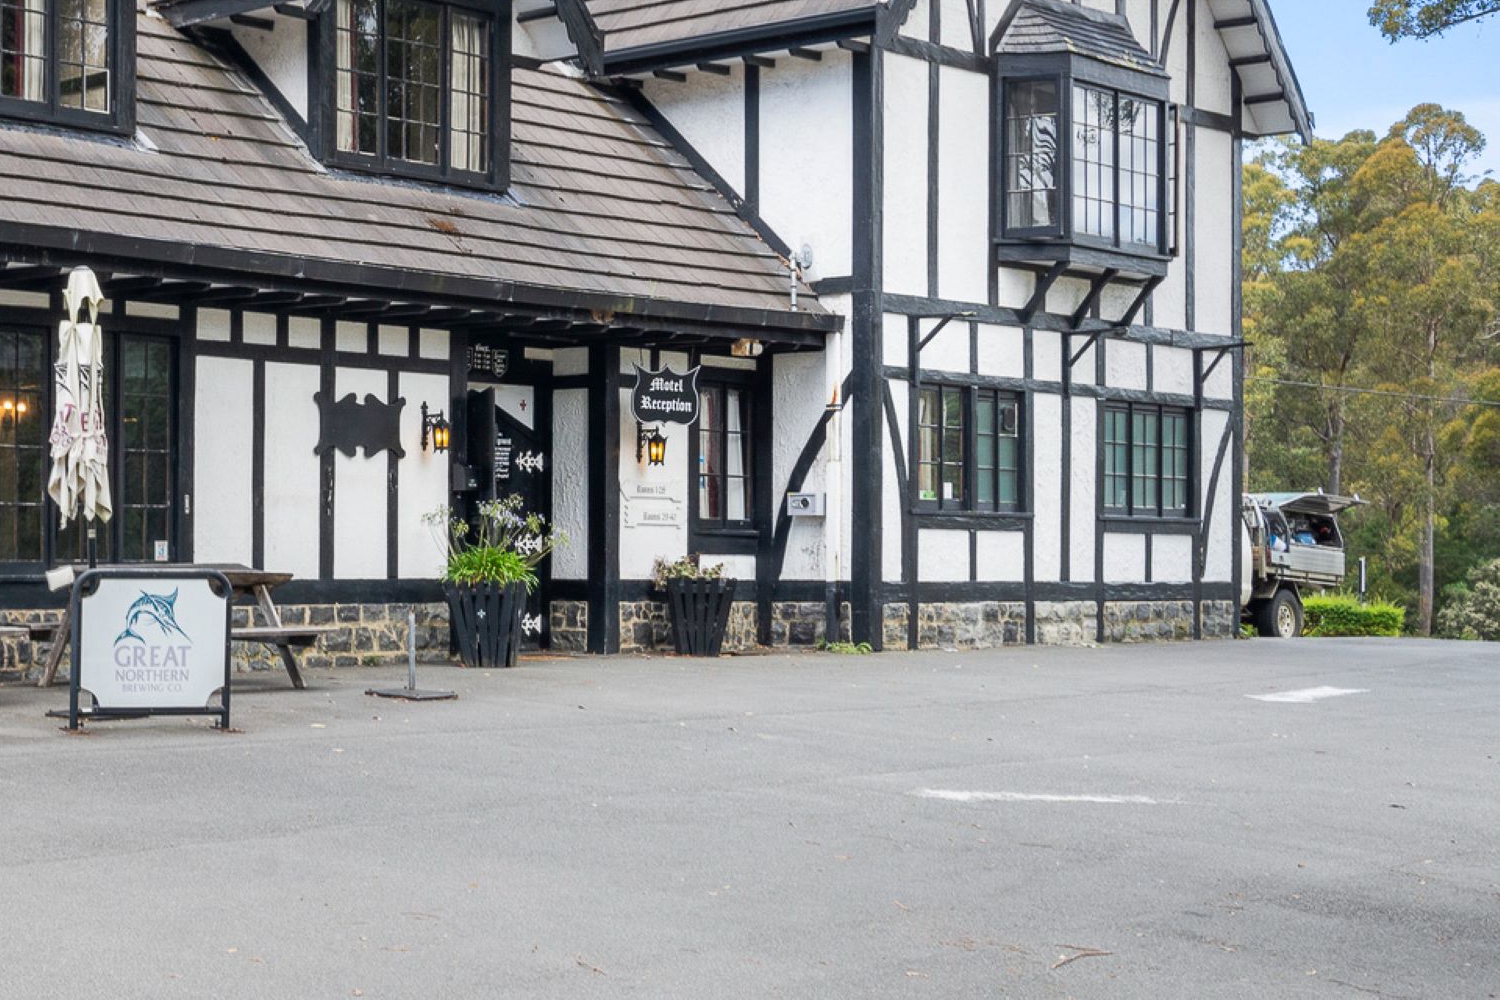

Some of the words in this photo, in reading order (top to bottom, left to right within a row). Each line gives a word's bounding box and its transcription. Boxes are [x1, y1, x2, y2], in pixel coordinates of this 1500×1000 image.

[649, 377, 684, 393] Motel
[640, 394, 692, 412] Reception
[114, 645, 192, 668] GREAT
[115, 669, 190, 682] NORTHERN
[121, 683, 164, 693] BREWING
